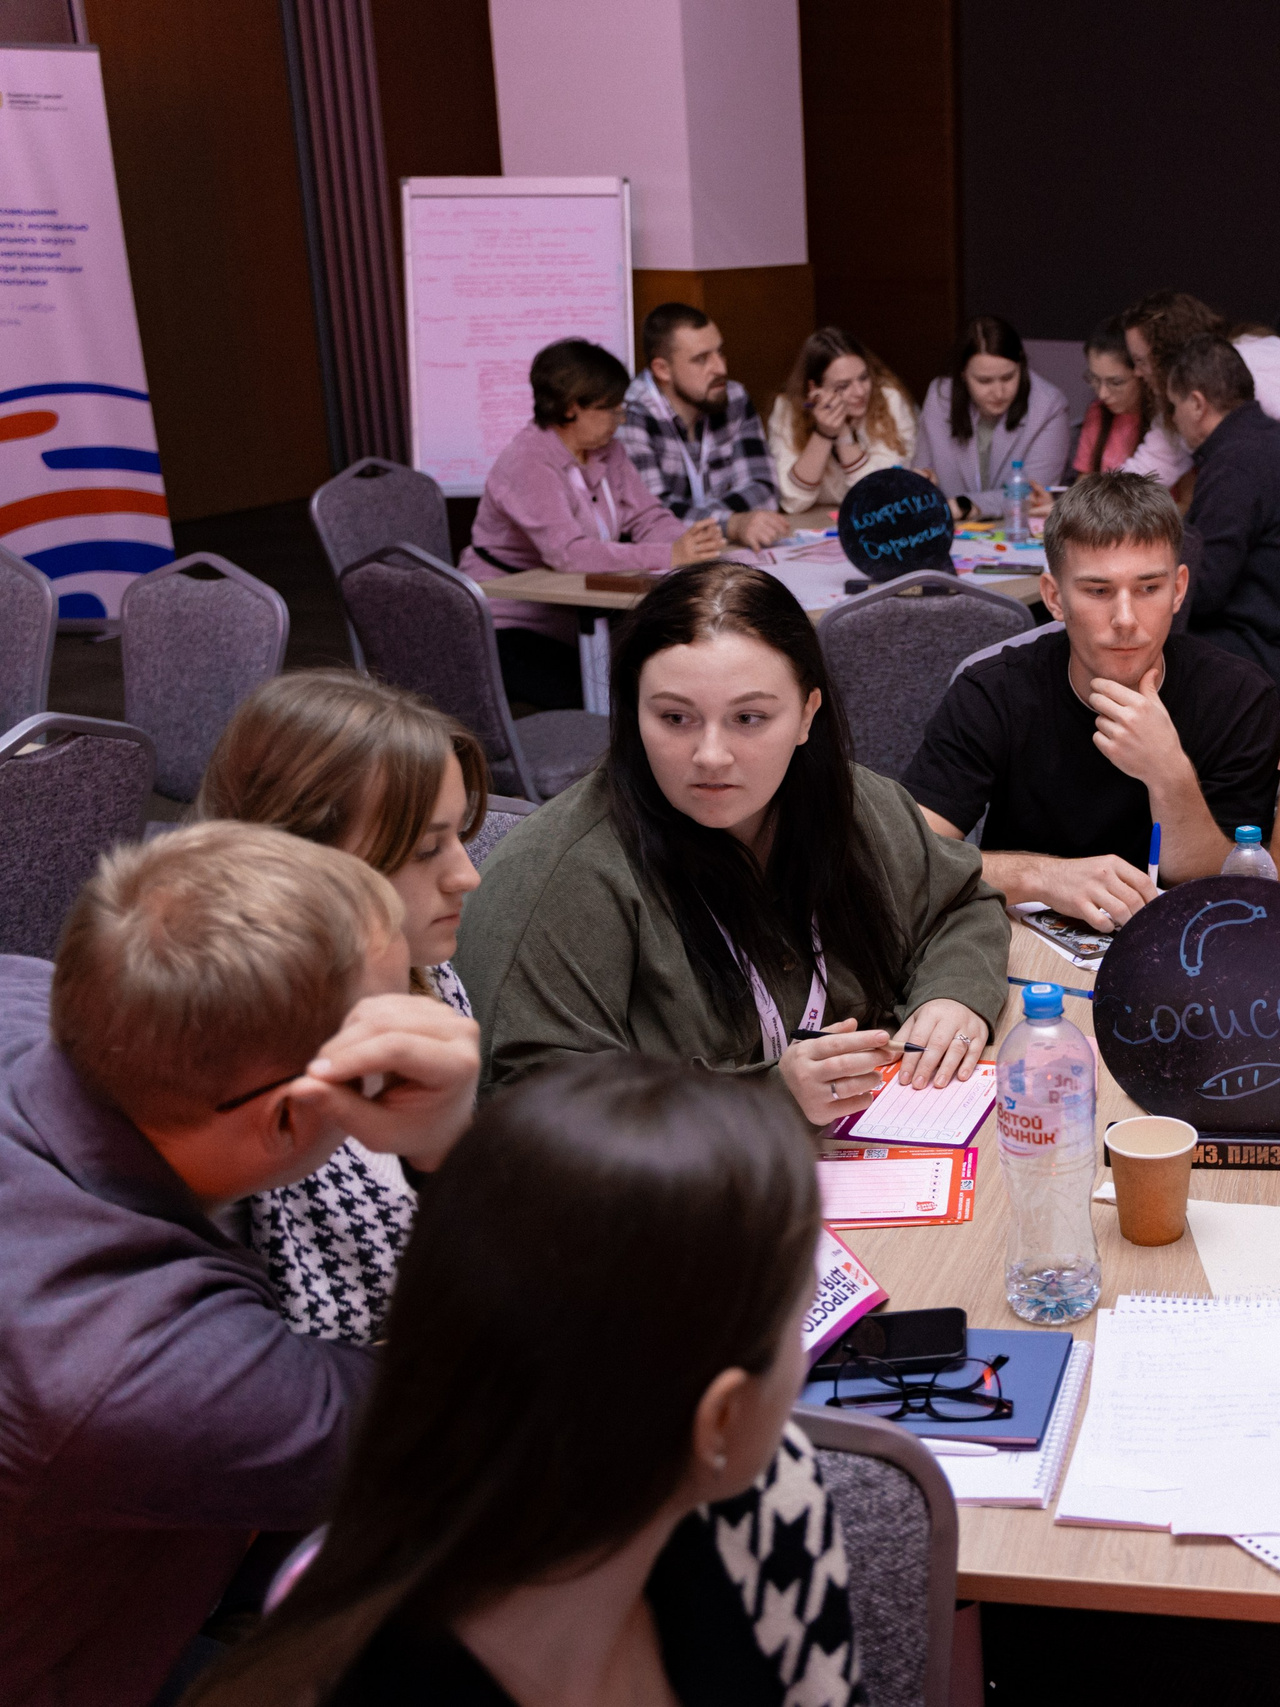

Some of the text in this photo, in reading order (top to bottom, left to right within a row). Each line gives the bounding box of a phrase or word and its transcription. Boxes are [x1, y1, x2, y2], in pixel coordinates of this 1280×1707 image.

[997, 1102, 1043, 1130] ВЯТОЙ
[998, 1119, 1056, 1145] ТОЧНИК
[1192, 1145, 1223, 1165] ИЗ,
[820, 1266, 847, 1291] ДЛЯ
[841, 1279, 861, 1295] НЕ
